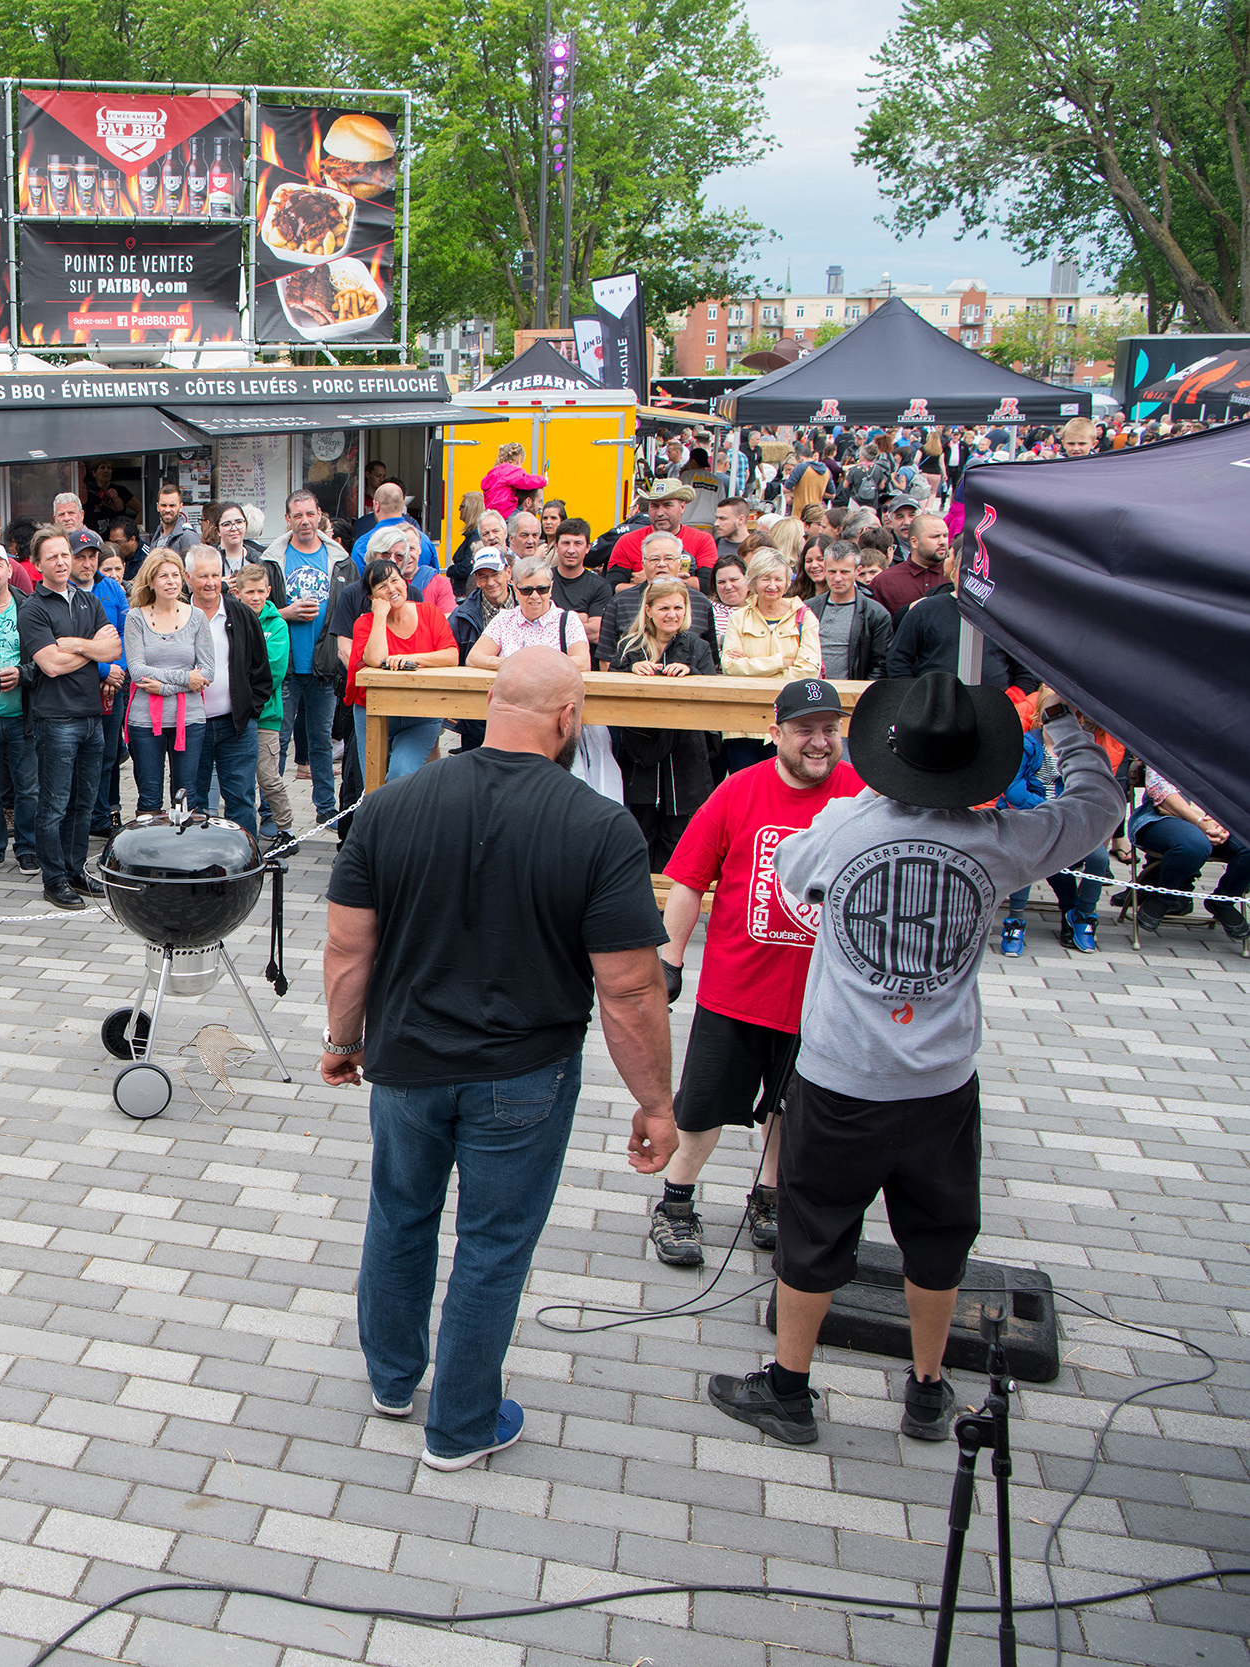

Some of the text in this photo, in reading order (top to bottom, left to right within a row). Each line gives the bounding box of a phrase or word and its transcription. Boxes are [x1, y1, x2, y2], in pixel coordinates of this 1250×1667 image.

[96, 123, 166, 137] PAT BBQ
[64, 254, 194, 273] POINTS DE VENTES
[69, 278, 188, 298] sur PATBBQ.com
[73, 315, 188, 326] Suivez-nous! PatBBQ.RDL
[11, 383, 46, 400] BBQ
[62, 379, 170, 398] ÉVÈNEMENTS
[185, 377, 236, 396] CÔTES
[240, 376, 298, 395] LEVÉES
[312, 378, 354, 394] PORC
[358, 374, 439, 393] EFFILOCHÉ
[291, 582, 326, 590] ALOHA
[752, 830, 780, 938] REMPARTS
[832, 886, 846, 910] AND
[843, 846, 901, 884] SMOKERS
[908, 844, 948, 859] FROM
[952, 855, 968, 869] LA
[969, 867, 991, 900] BELLE
[768, 930, 806, 941] QUÉBEC
[868, 971, 949, 996] QUÉBEC
